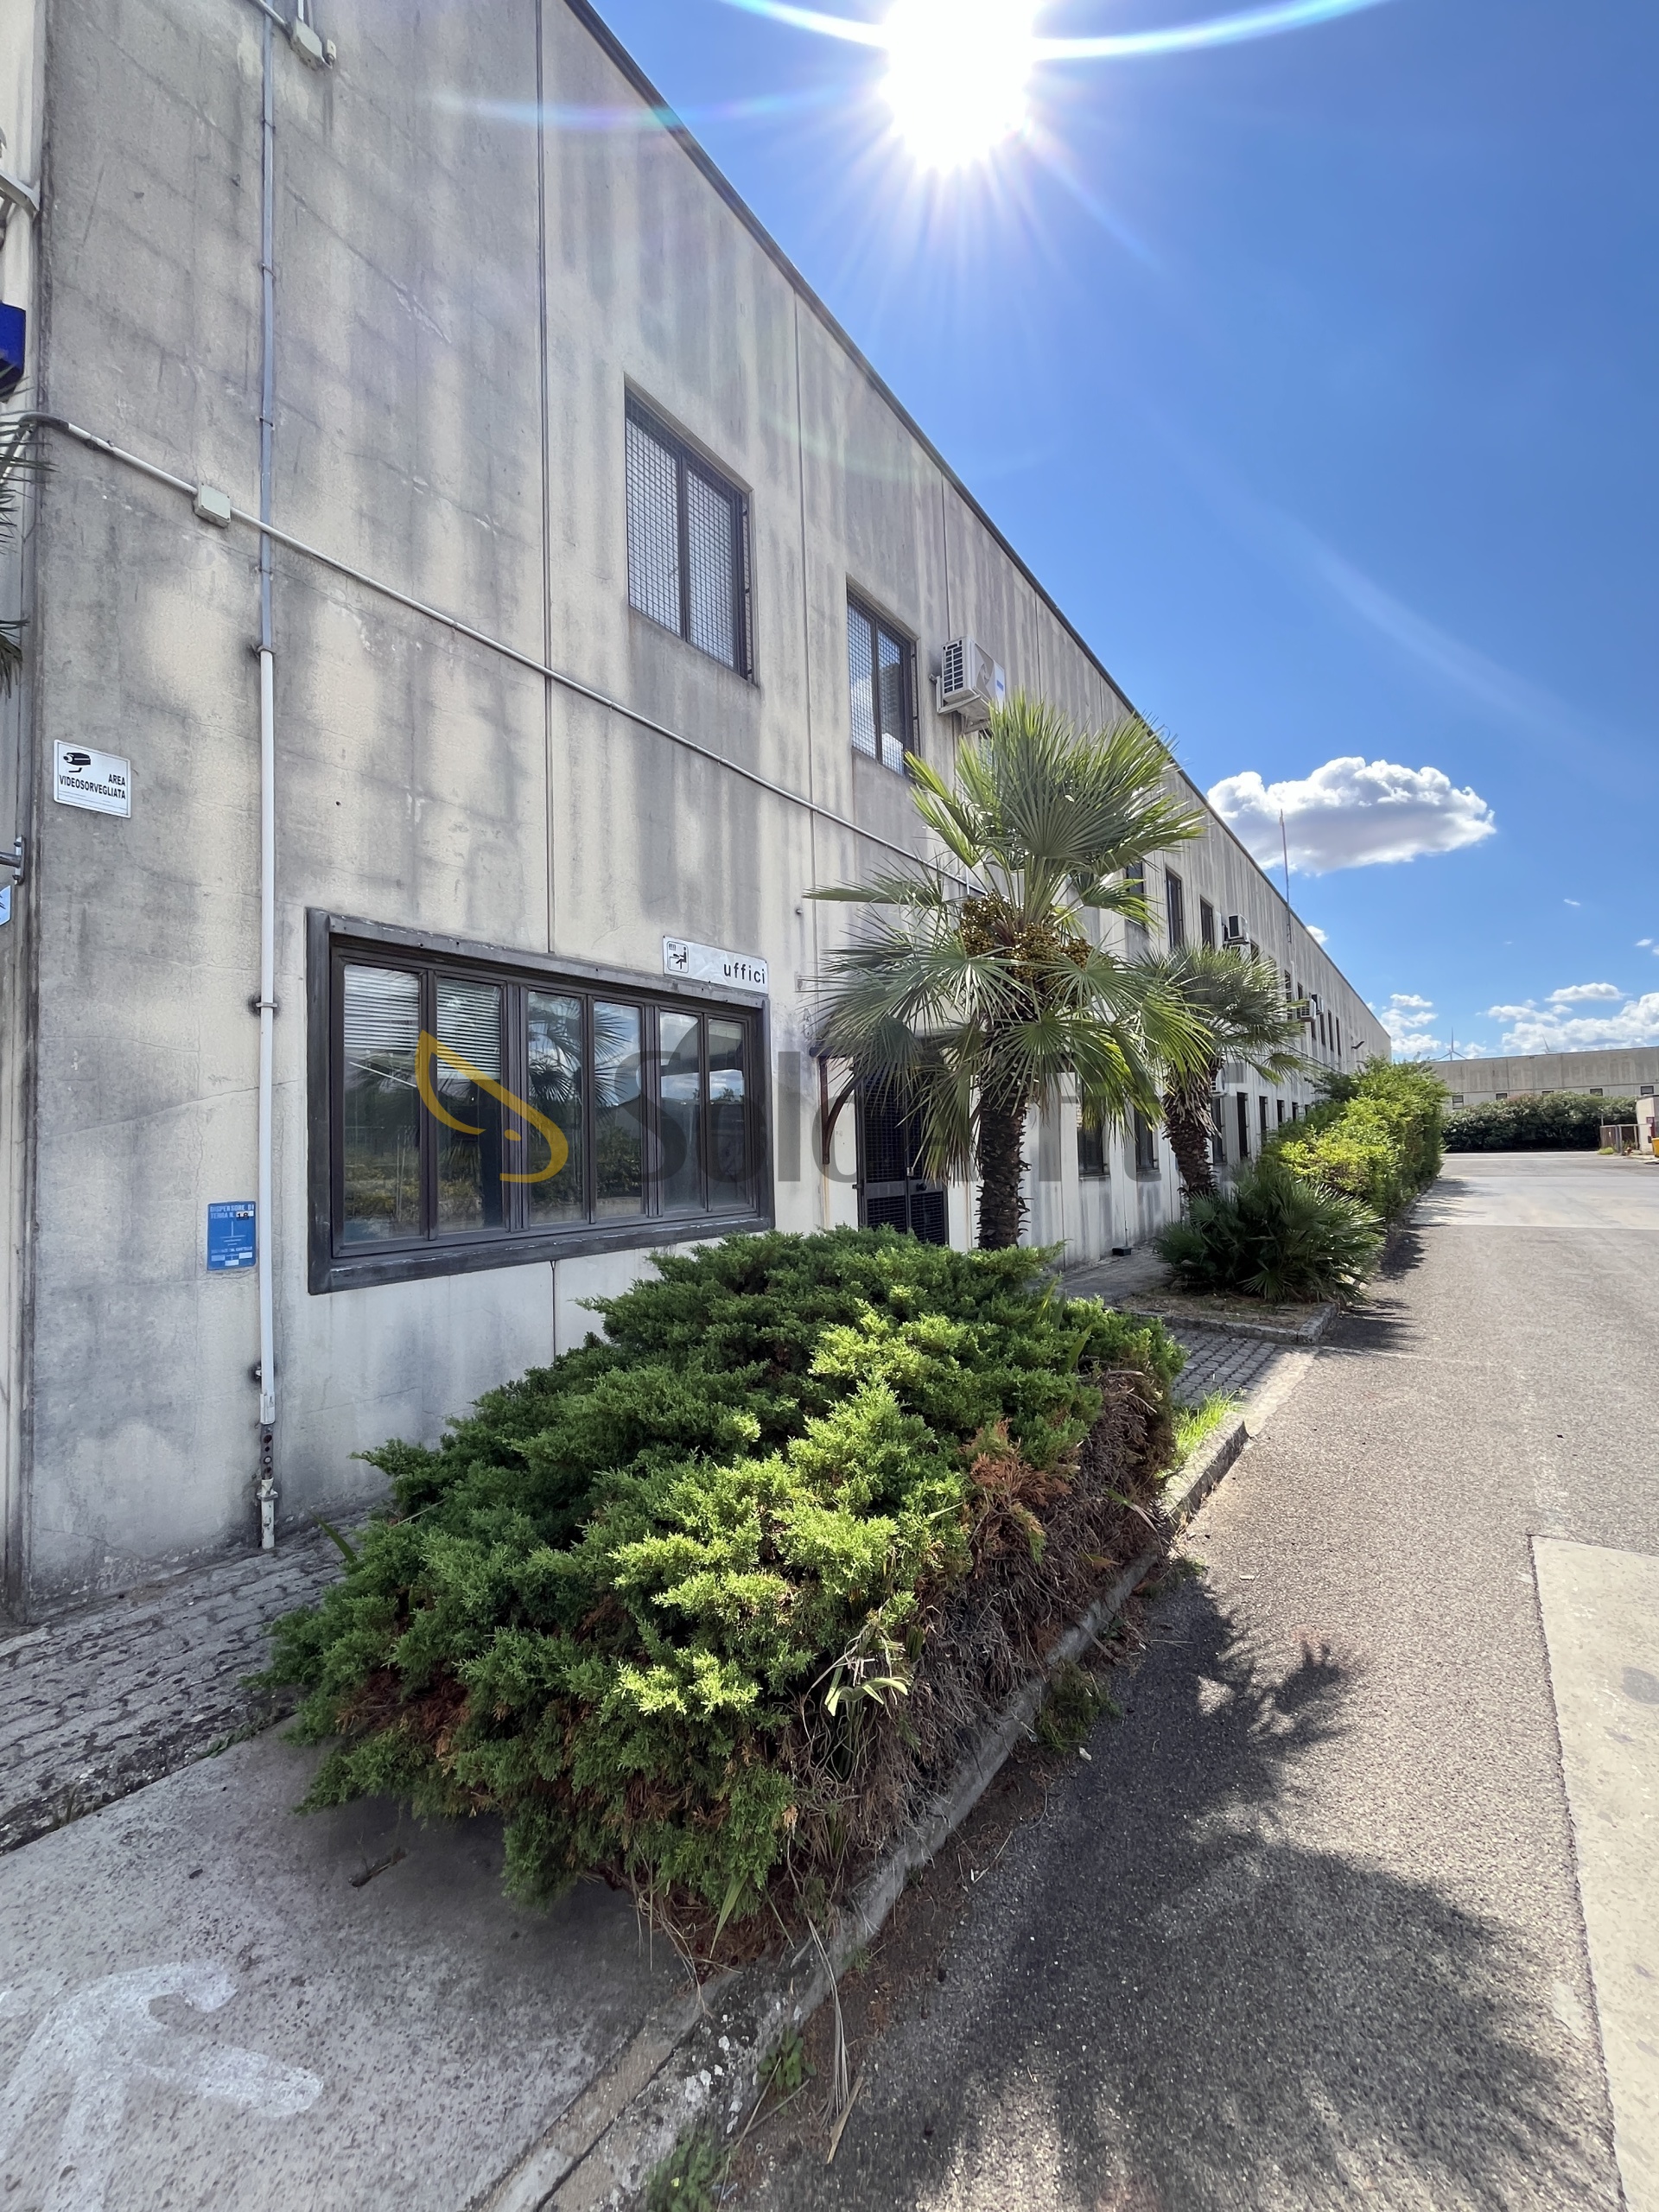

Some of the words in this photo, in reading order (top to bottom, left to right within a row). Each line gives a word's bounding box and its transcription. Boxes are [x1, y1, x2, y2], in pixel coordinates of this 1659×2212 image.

[59, 774, 126, 800] VIDEOSORVEGLIATA
[108, 773, 126, 787] AREA
[723, 962, 766, 984] uffici
